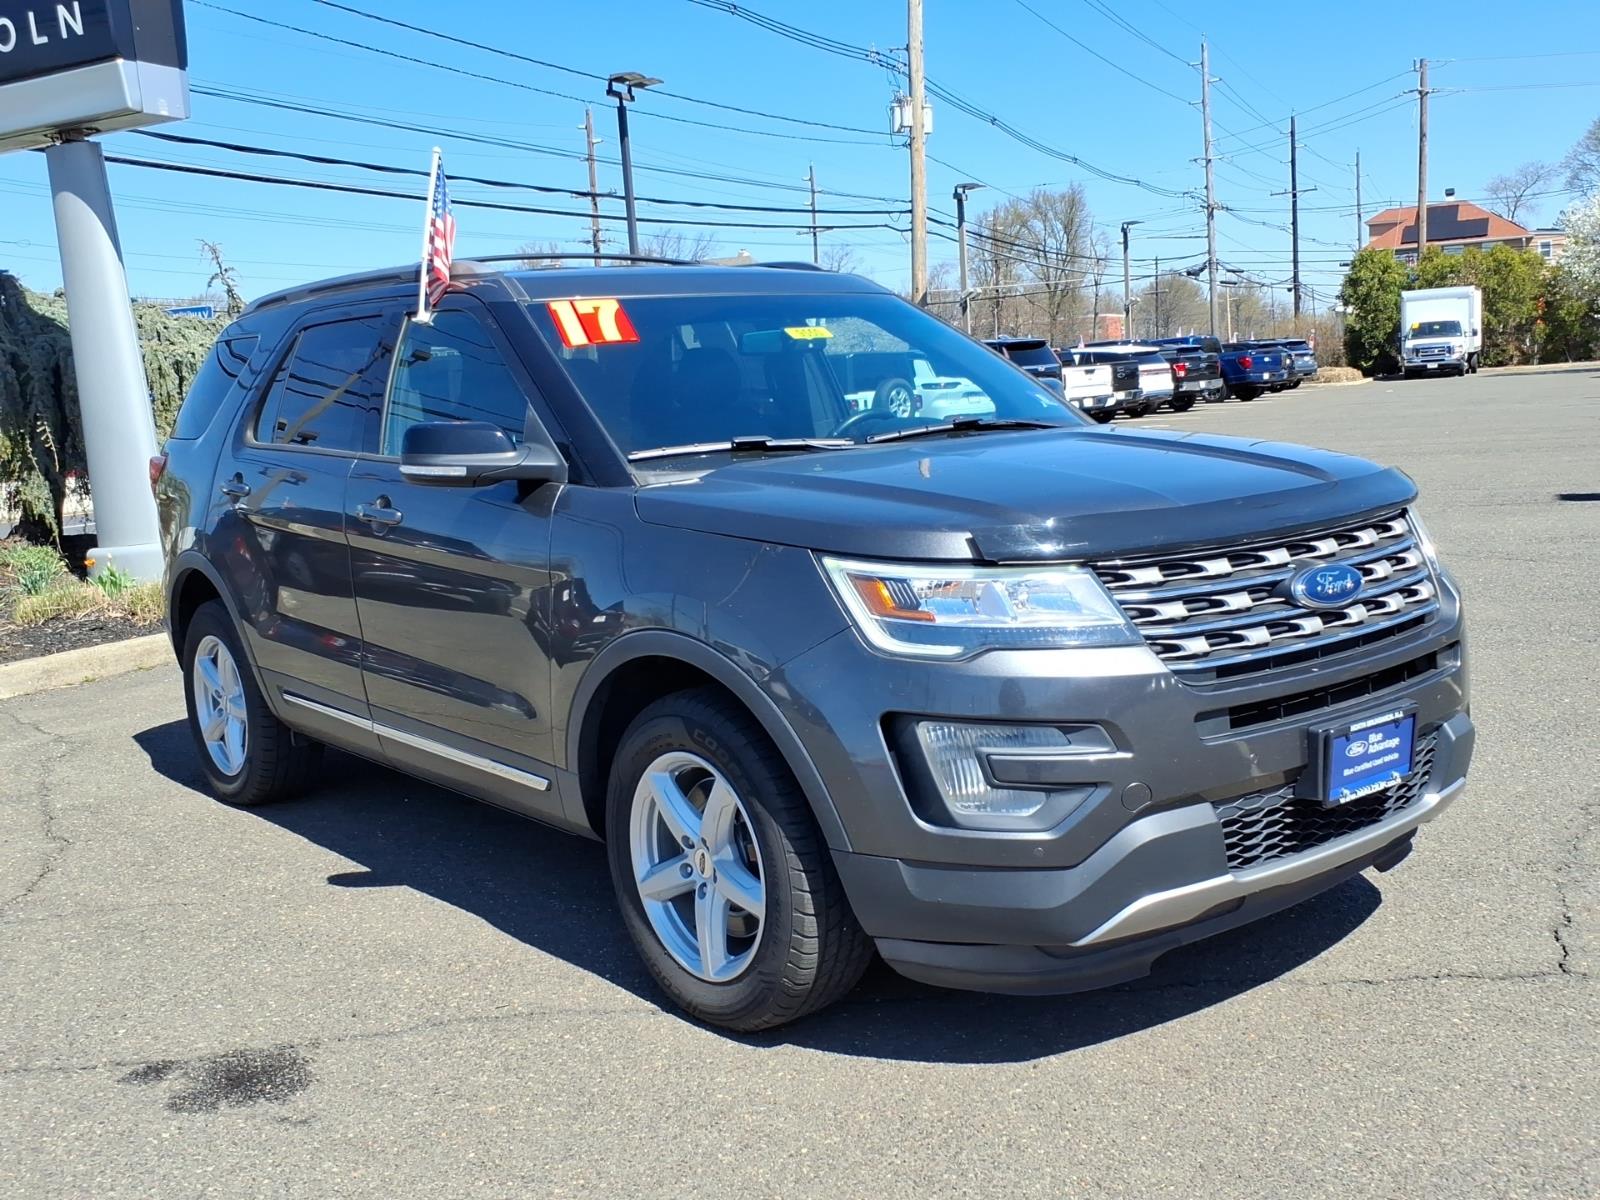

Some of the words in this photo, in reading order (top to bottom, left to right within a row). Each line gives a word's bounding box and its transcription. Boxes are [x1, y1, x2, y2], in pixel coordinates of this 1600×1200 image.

[549, 299, 623, 346] 17
[1316, 570, 1354, 594] Ford
[1367, 737, 1400, 754] Advantage
[1368, 732, 1383, 743] Blue
